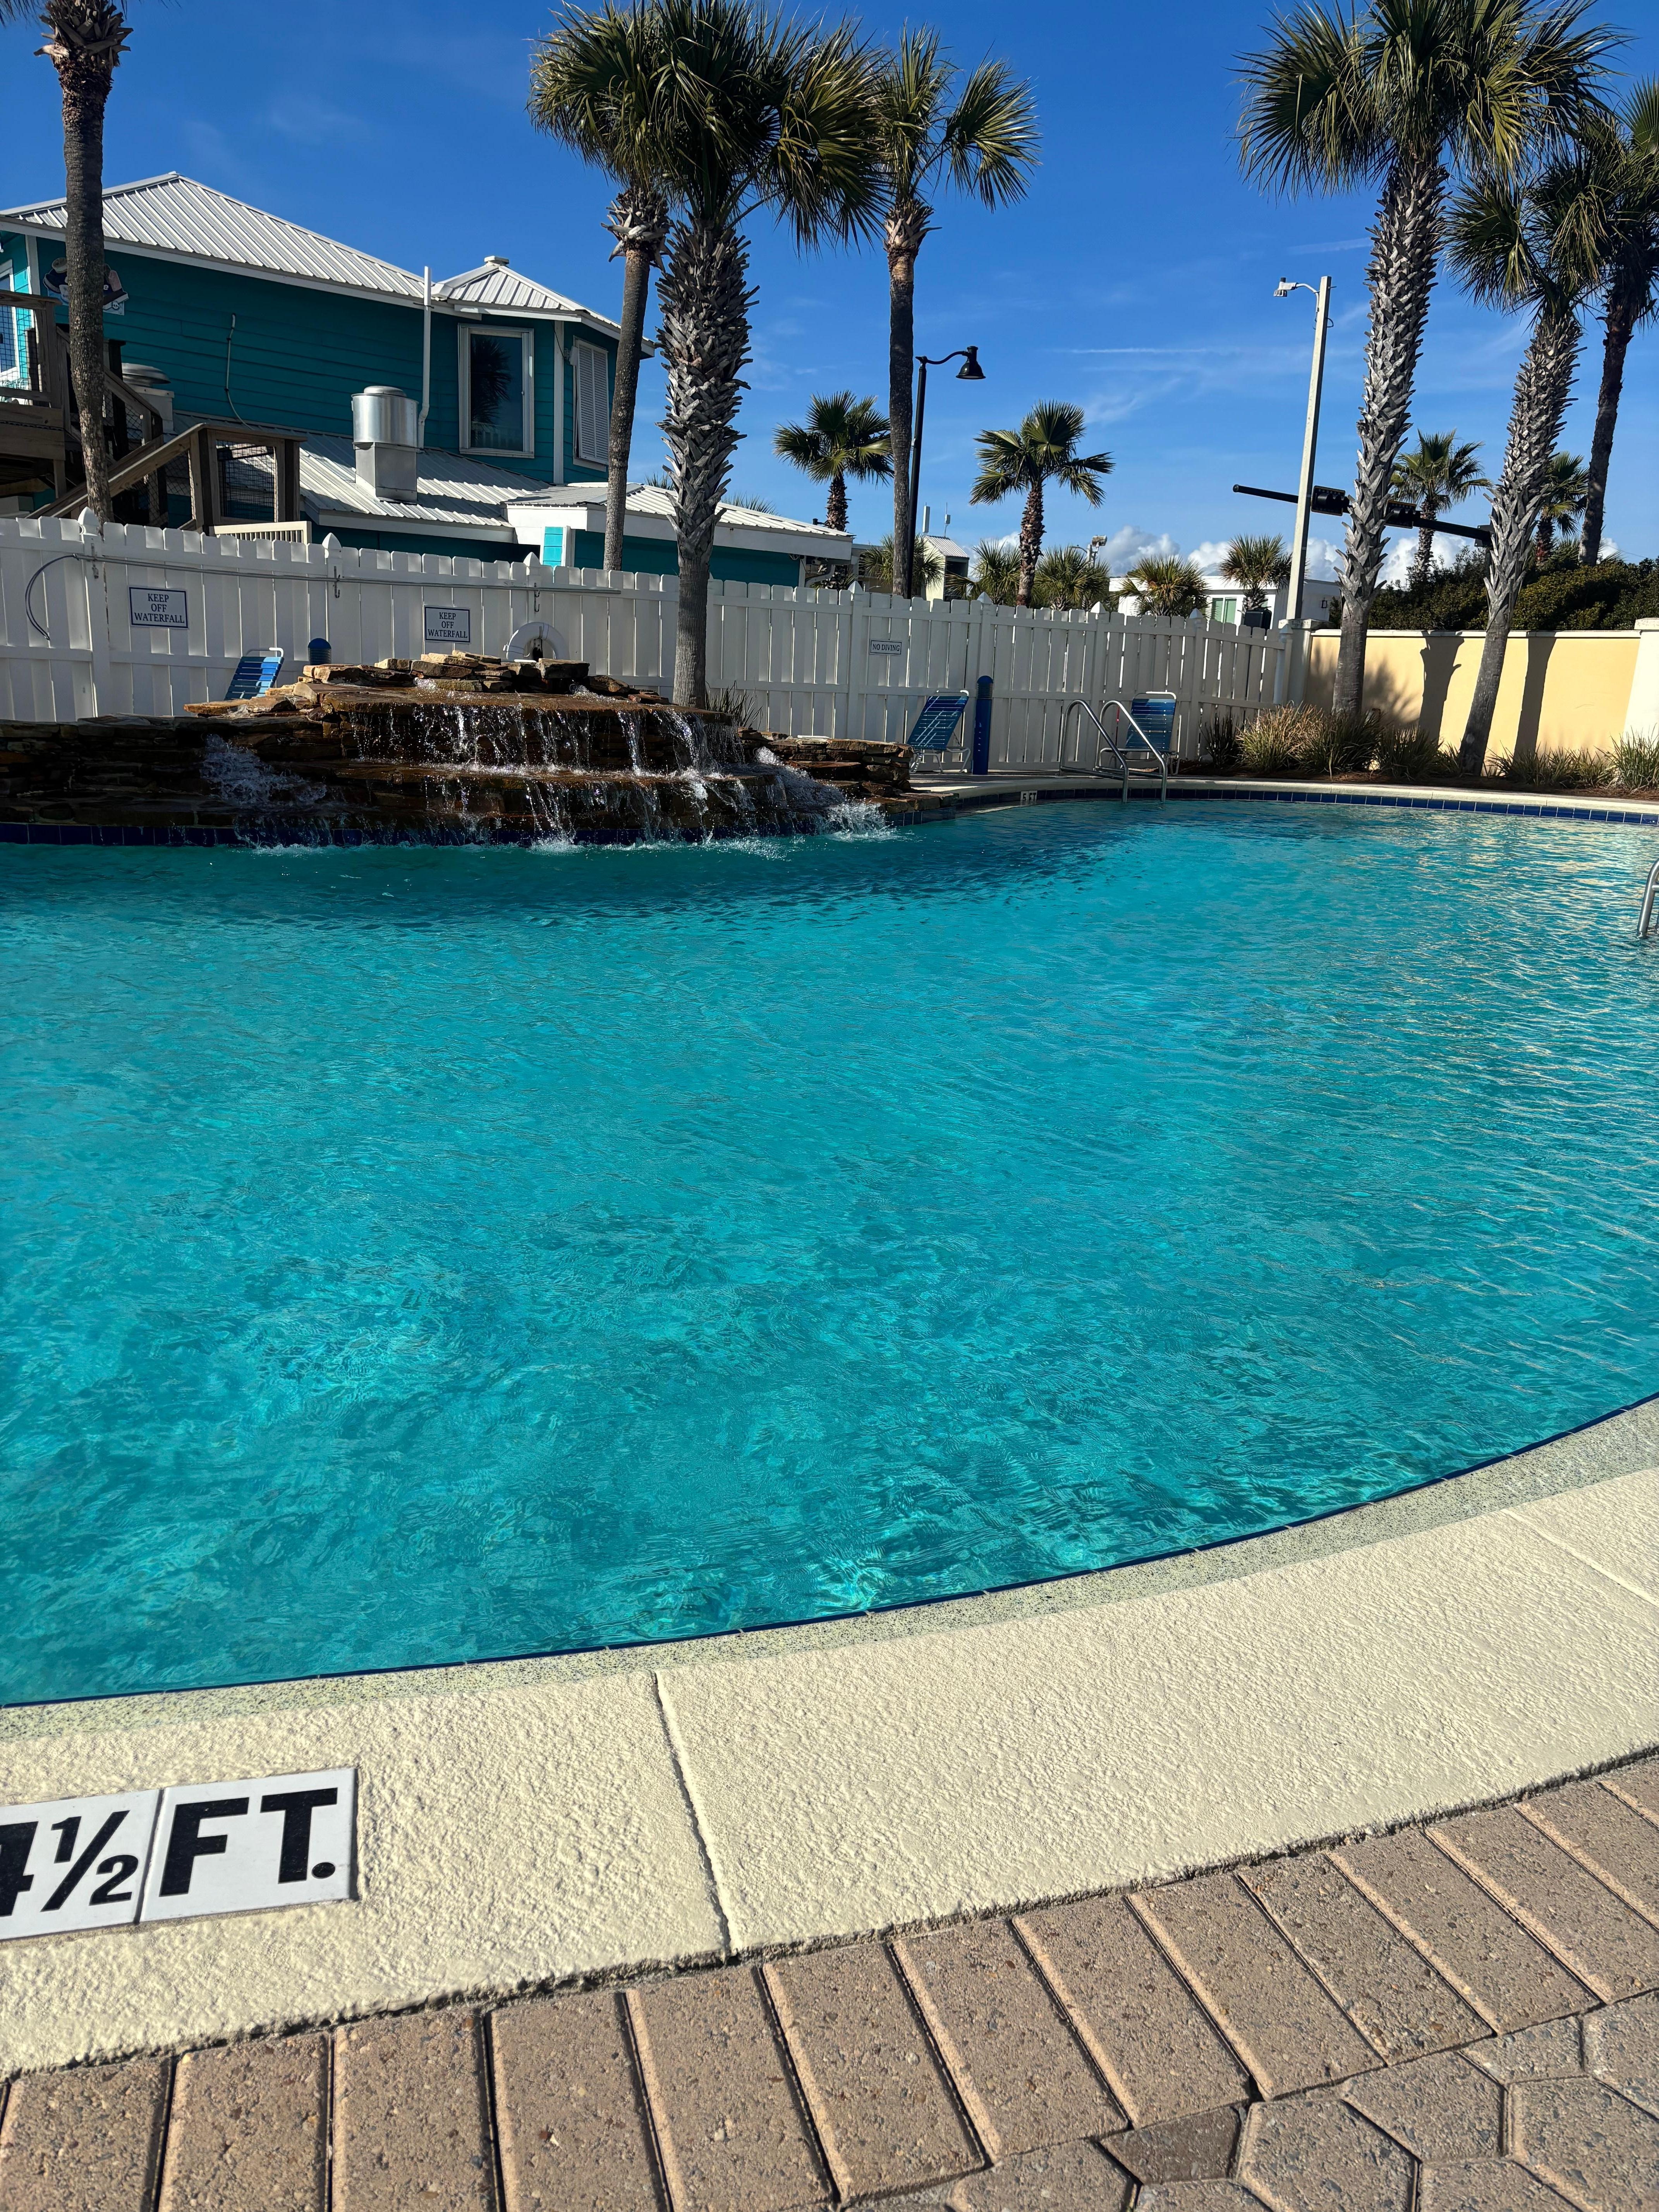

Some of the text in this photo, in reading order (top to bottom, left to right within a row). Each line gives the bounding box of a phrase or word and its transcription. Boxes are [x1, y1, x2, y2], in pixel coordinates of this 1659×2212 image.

[148, 593, 169, 603] KEEP
[151, 603, 167, 612] OFF
[134, 612, 185, 623] WATERFALL
[439, 612, 456, 620] KEEP
[428, 629, 468, 638] WATERFALL
[1029, 792, 1037, 801] FT
[159, 1787, 338, 1897] FT.
